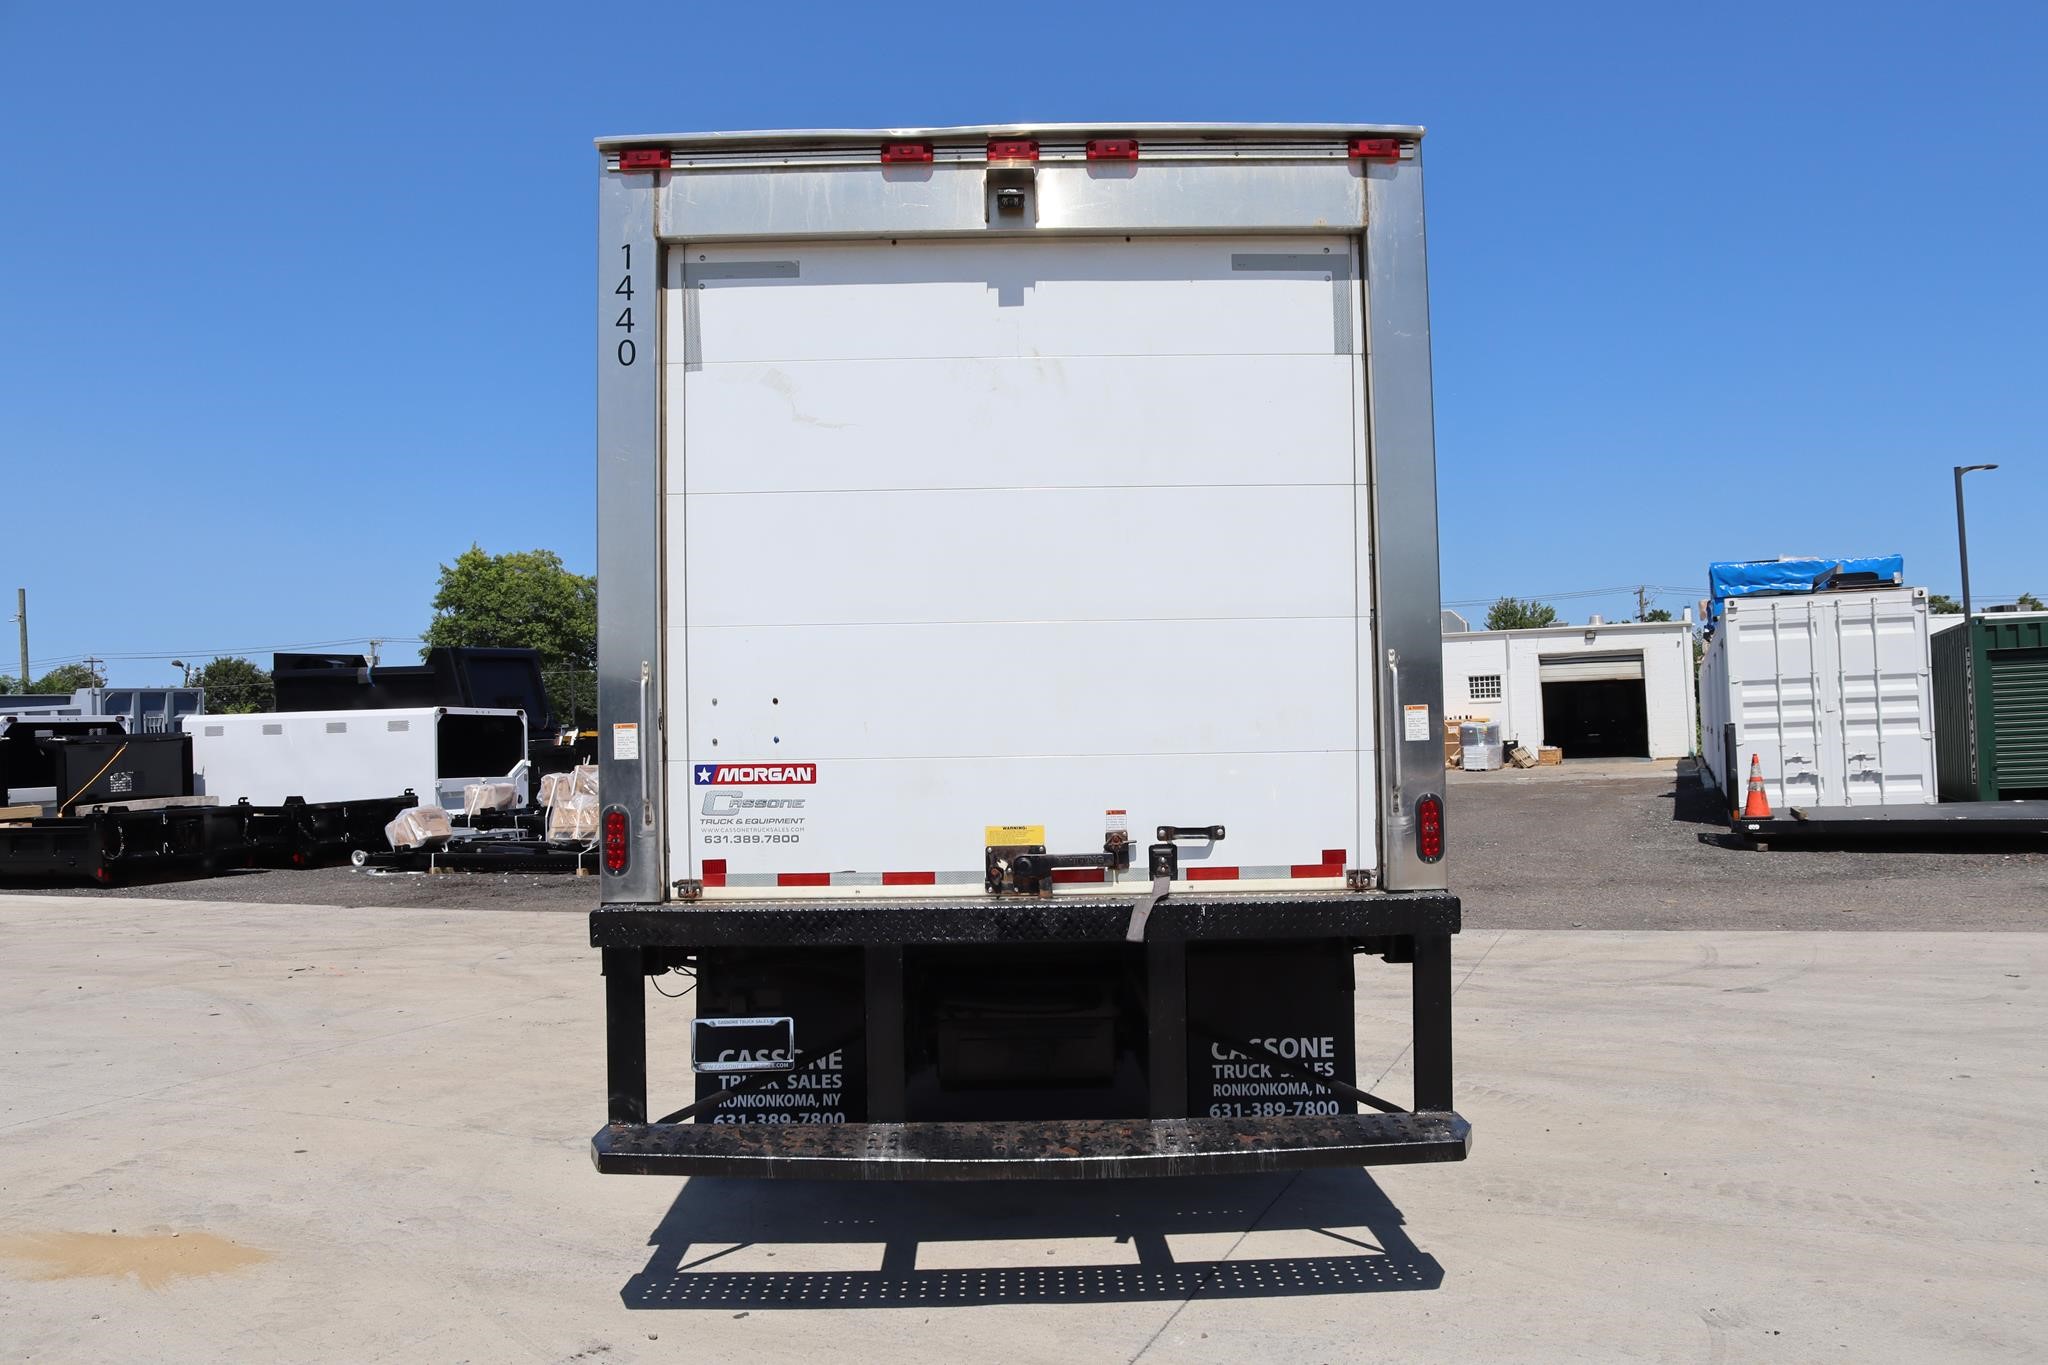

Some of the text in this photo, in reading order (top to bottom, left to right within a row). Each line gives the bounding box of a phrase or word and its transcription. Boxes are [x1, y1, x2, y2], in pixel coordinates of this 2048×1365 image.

[615, 244, 636, 366] 1440
[717, 767, 811, 782] MORGAN
[744, 817, 805, 825] EQUIPMENT
[704, 835, 800, 844] 631.389.7800
[1211, 1036, 1335, 1060] CSONE
[718, 1049, 843, 1070] CASSNE
[1212, 1063, 1272, 1079] TRUCK
[787, 1074, 843, 1089] SALES
[1213, 1082, 1313, 1097] RONKONKOMA,
[822, 1093, 842, 1106] NY
[1209, 1100, 1339, 1118] 631-389-7800
